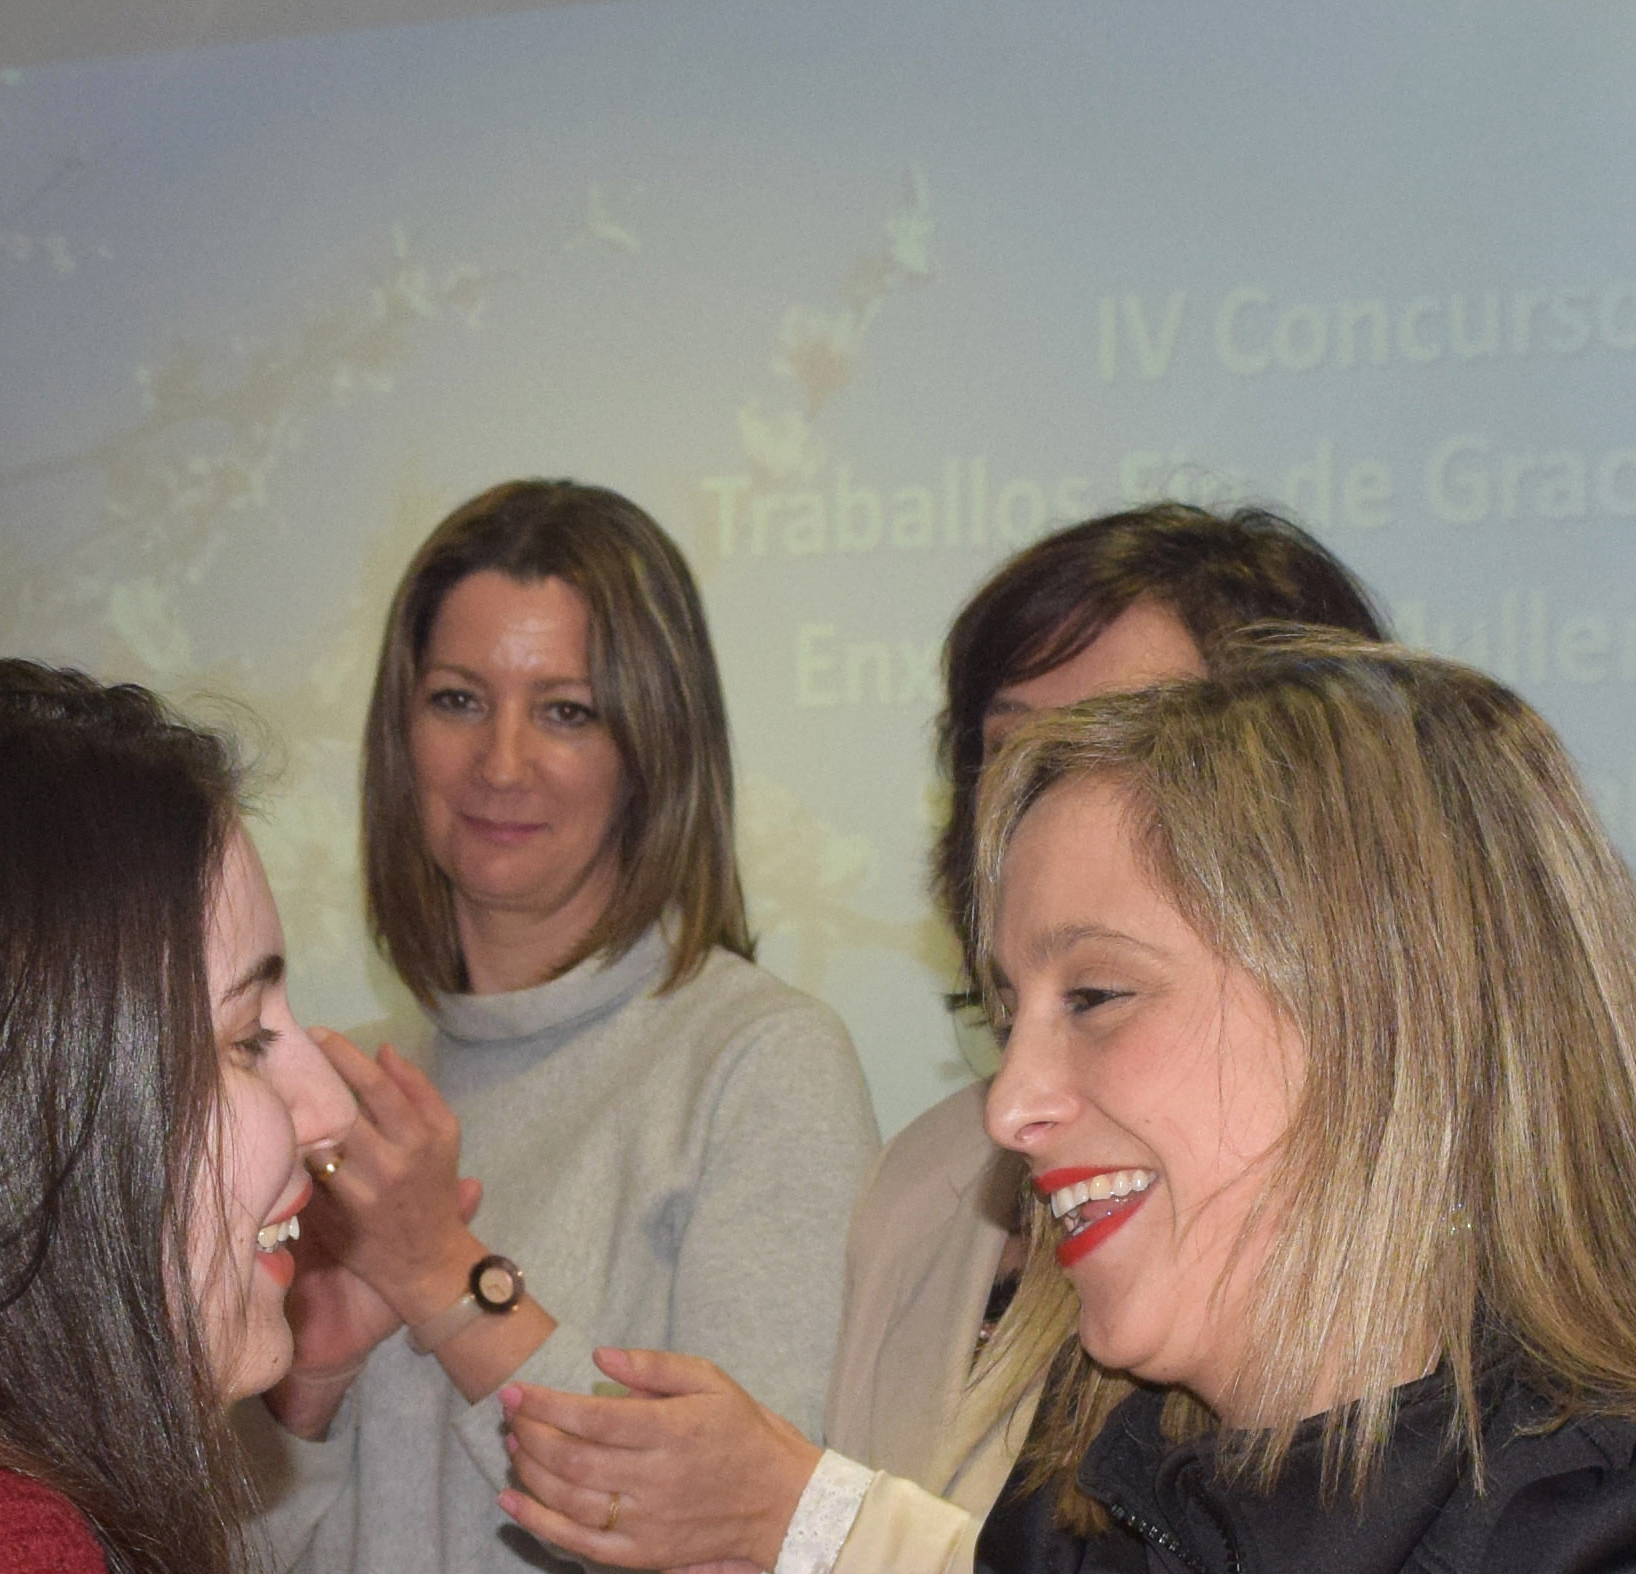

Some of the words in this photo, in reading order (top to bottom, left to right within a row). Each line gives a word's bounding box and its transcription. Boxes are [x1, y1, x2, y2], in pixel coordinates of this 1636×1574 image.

[1097, 289, 1186, 381] IV
[702, 454, 1091, 558] Traballos
[1285, 436, 1394, 530] de
[794, 621, 939, 708] Enx
